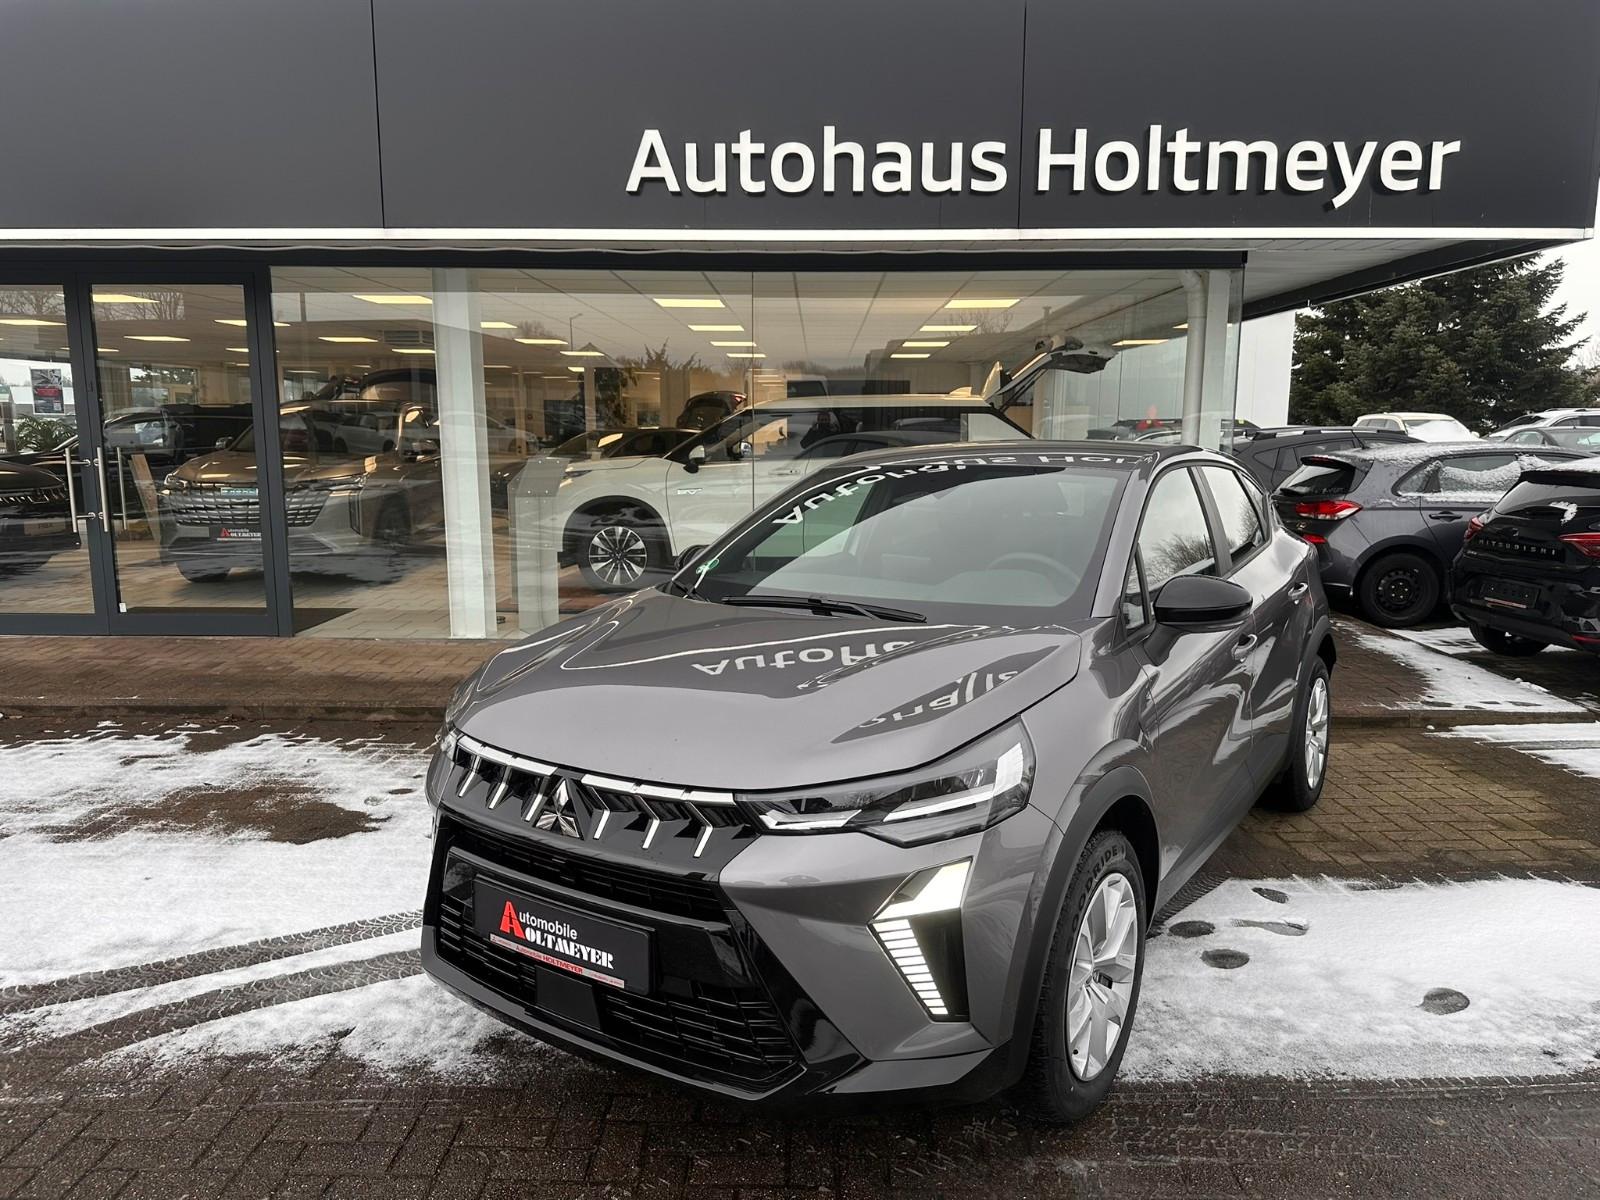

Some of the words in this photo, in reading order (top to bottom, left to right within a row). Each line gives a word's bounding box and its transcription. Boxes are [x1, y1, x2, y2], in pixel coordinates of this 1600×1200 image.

[625, 125, 1008, 193] Autohaus
[1037, 124, 1461, 209] Holtmeyer
[1479, 540, 1556, 556] MITSUBISHI
[500, 900, 577, 939] Automobile
[543, 955, 583, 975] HOLTMEYER
